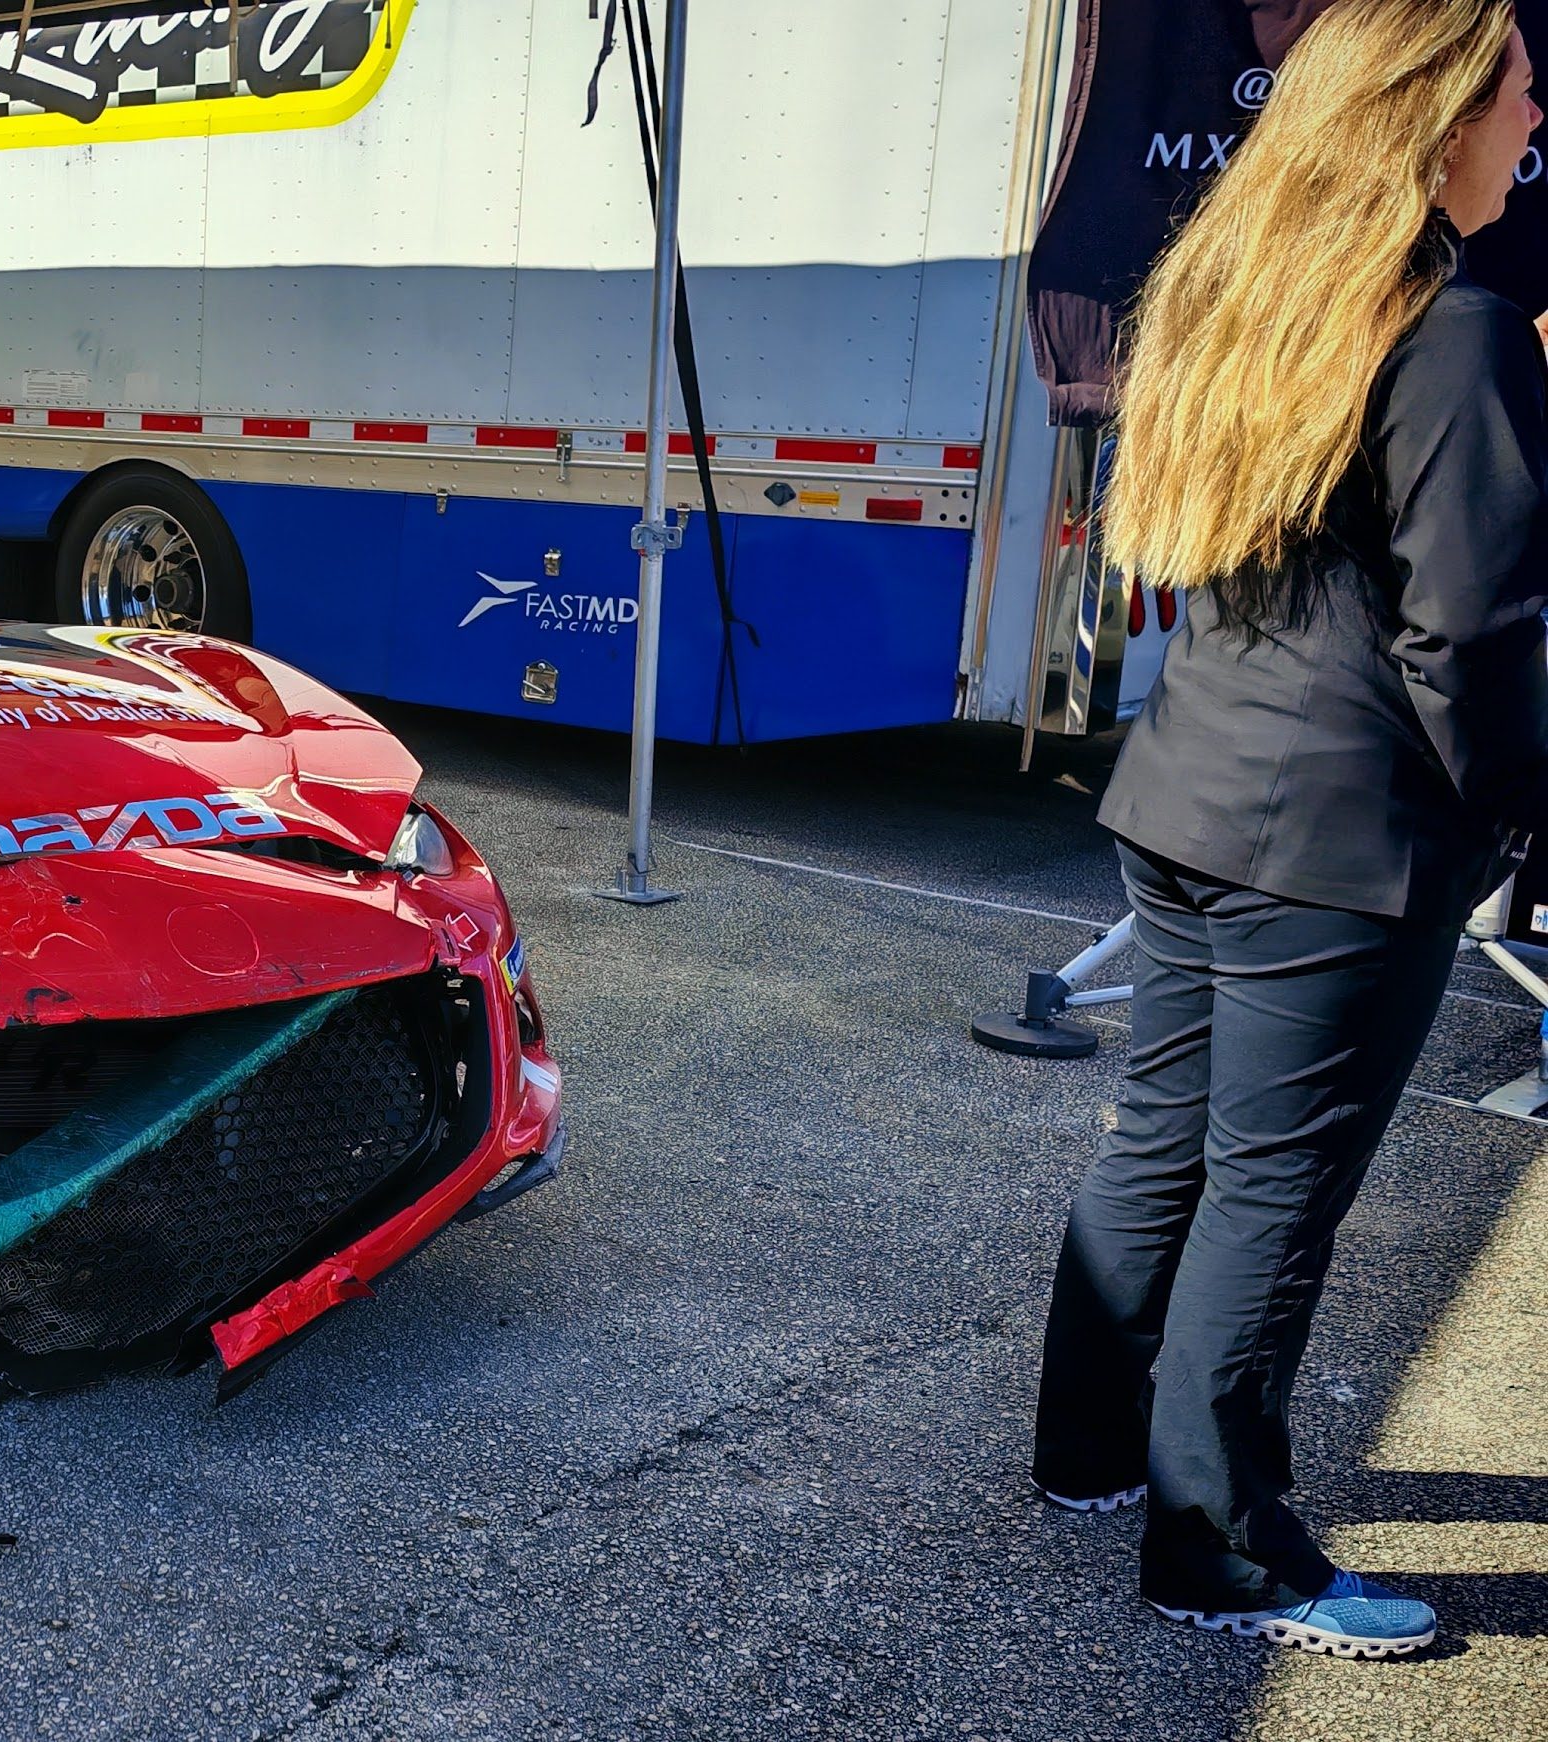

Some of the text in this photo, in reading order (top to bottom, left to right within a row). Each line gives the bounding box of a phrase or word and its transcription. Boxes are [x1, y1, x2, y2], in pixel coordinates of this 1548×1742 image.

[525, 593, 639, 623] FASTMD
[540, 619, 619, 634] RACING
[34, 699, 70, 722] of
